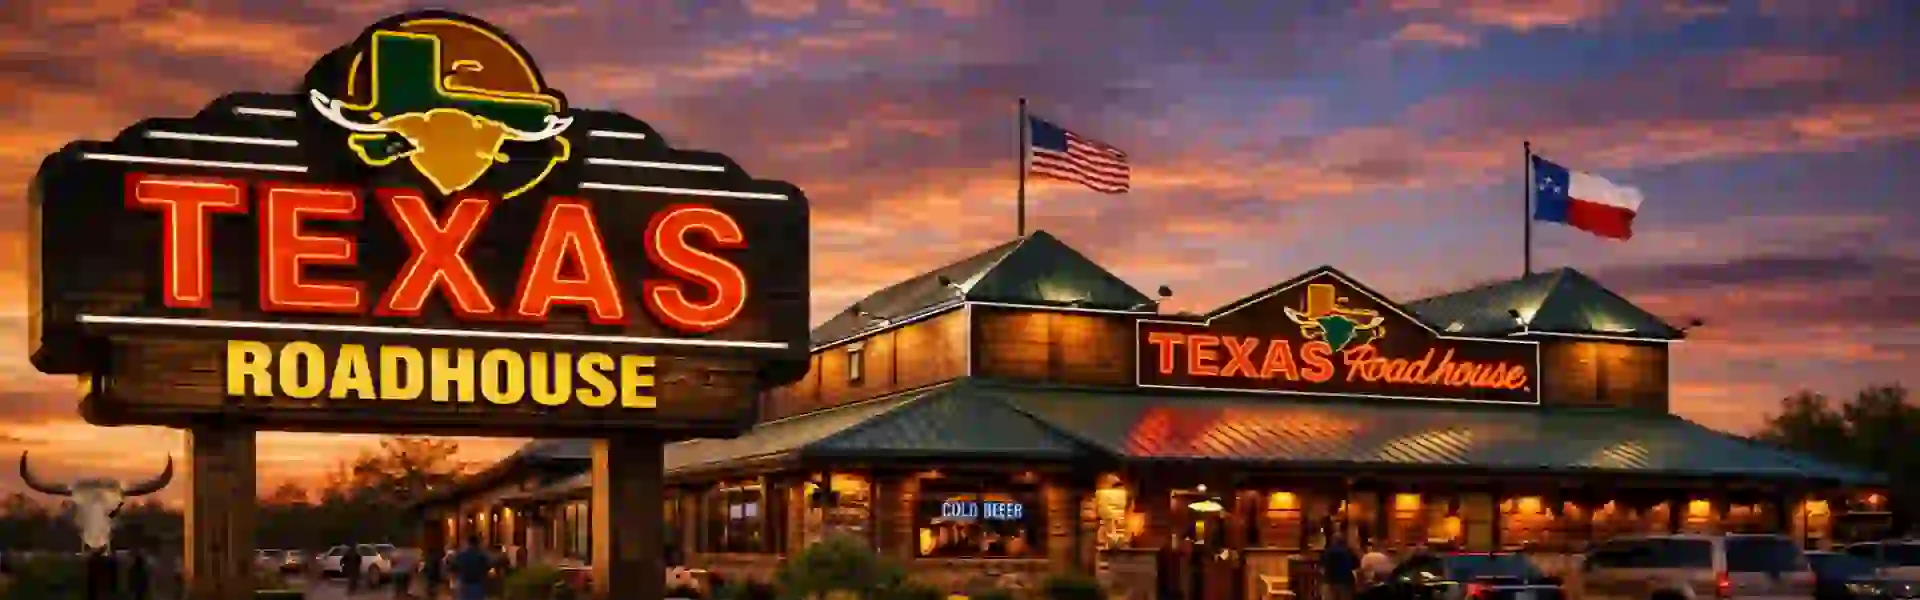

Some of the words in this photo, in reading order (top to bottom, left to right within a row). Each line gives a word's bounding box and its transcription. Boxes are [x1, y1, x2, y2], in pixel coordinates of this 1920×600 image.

[124, 173, 748, 333] TEXAS
[227, 340, 656, 408] ROADHOUSE
[1148, 331, 1335, 384] TEXAS
